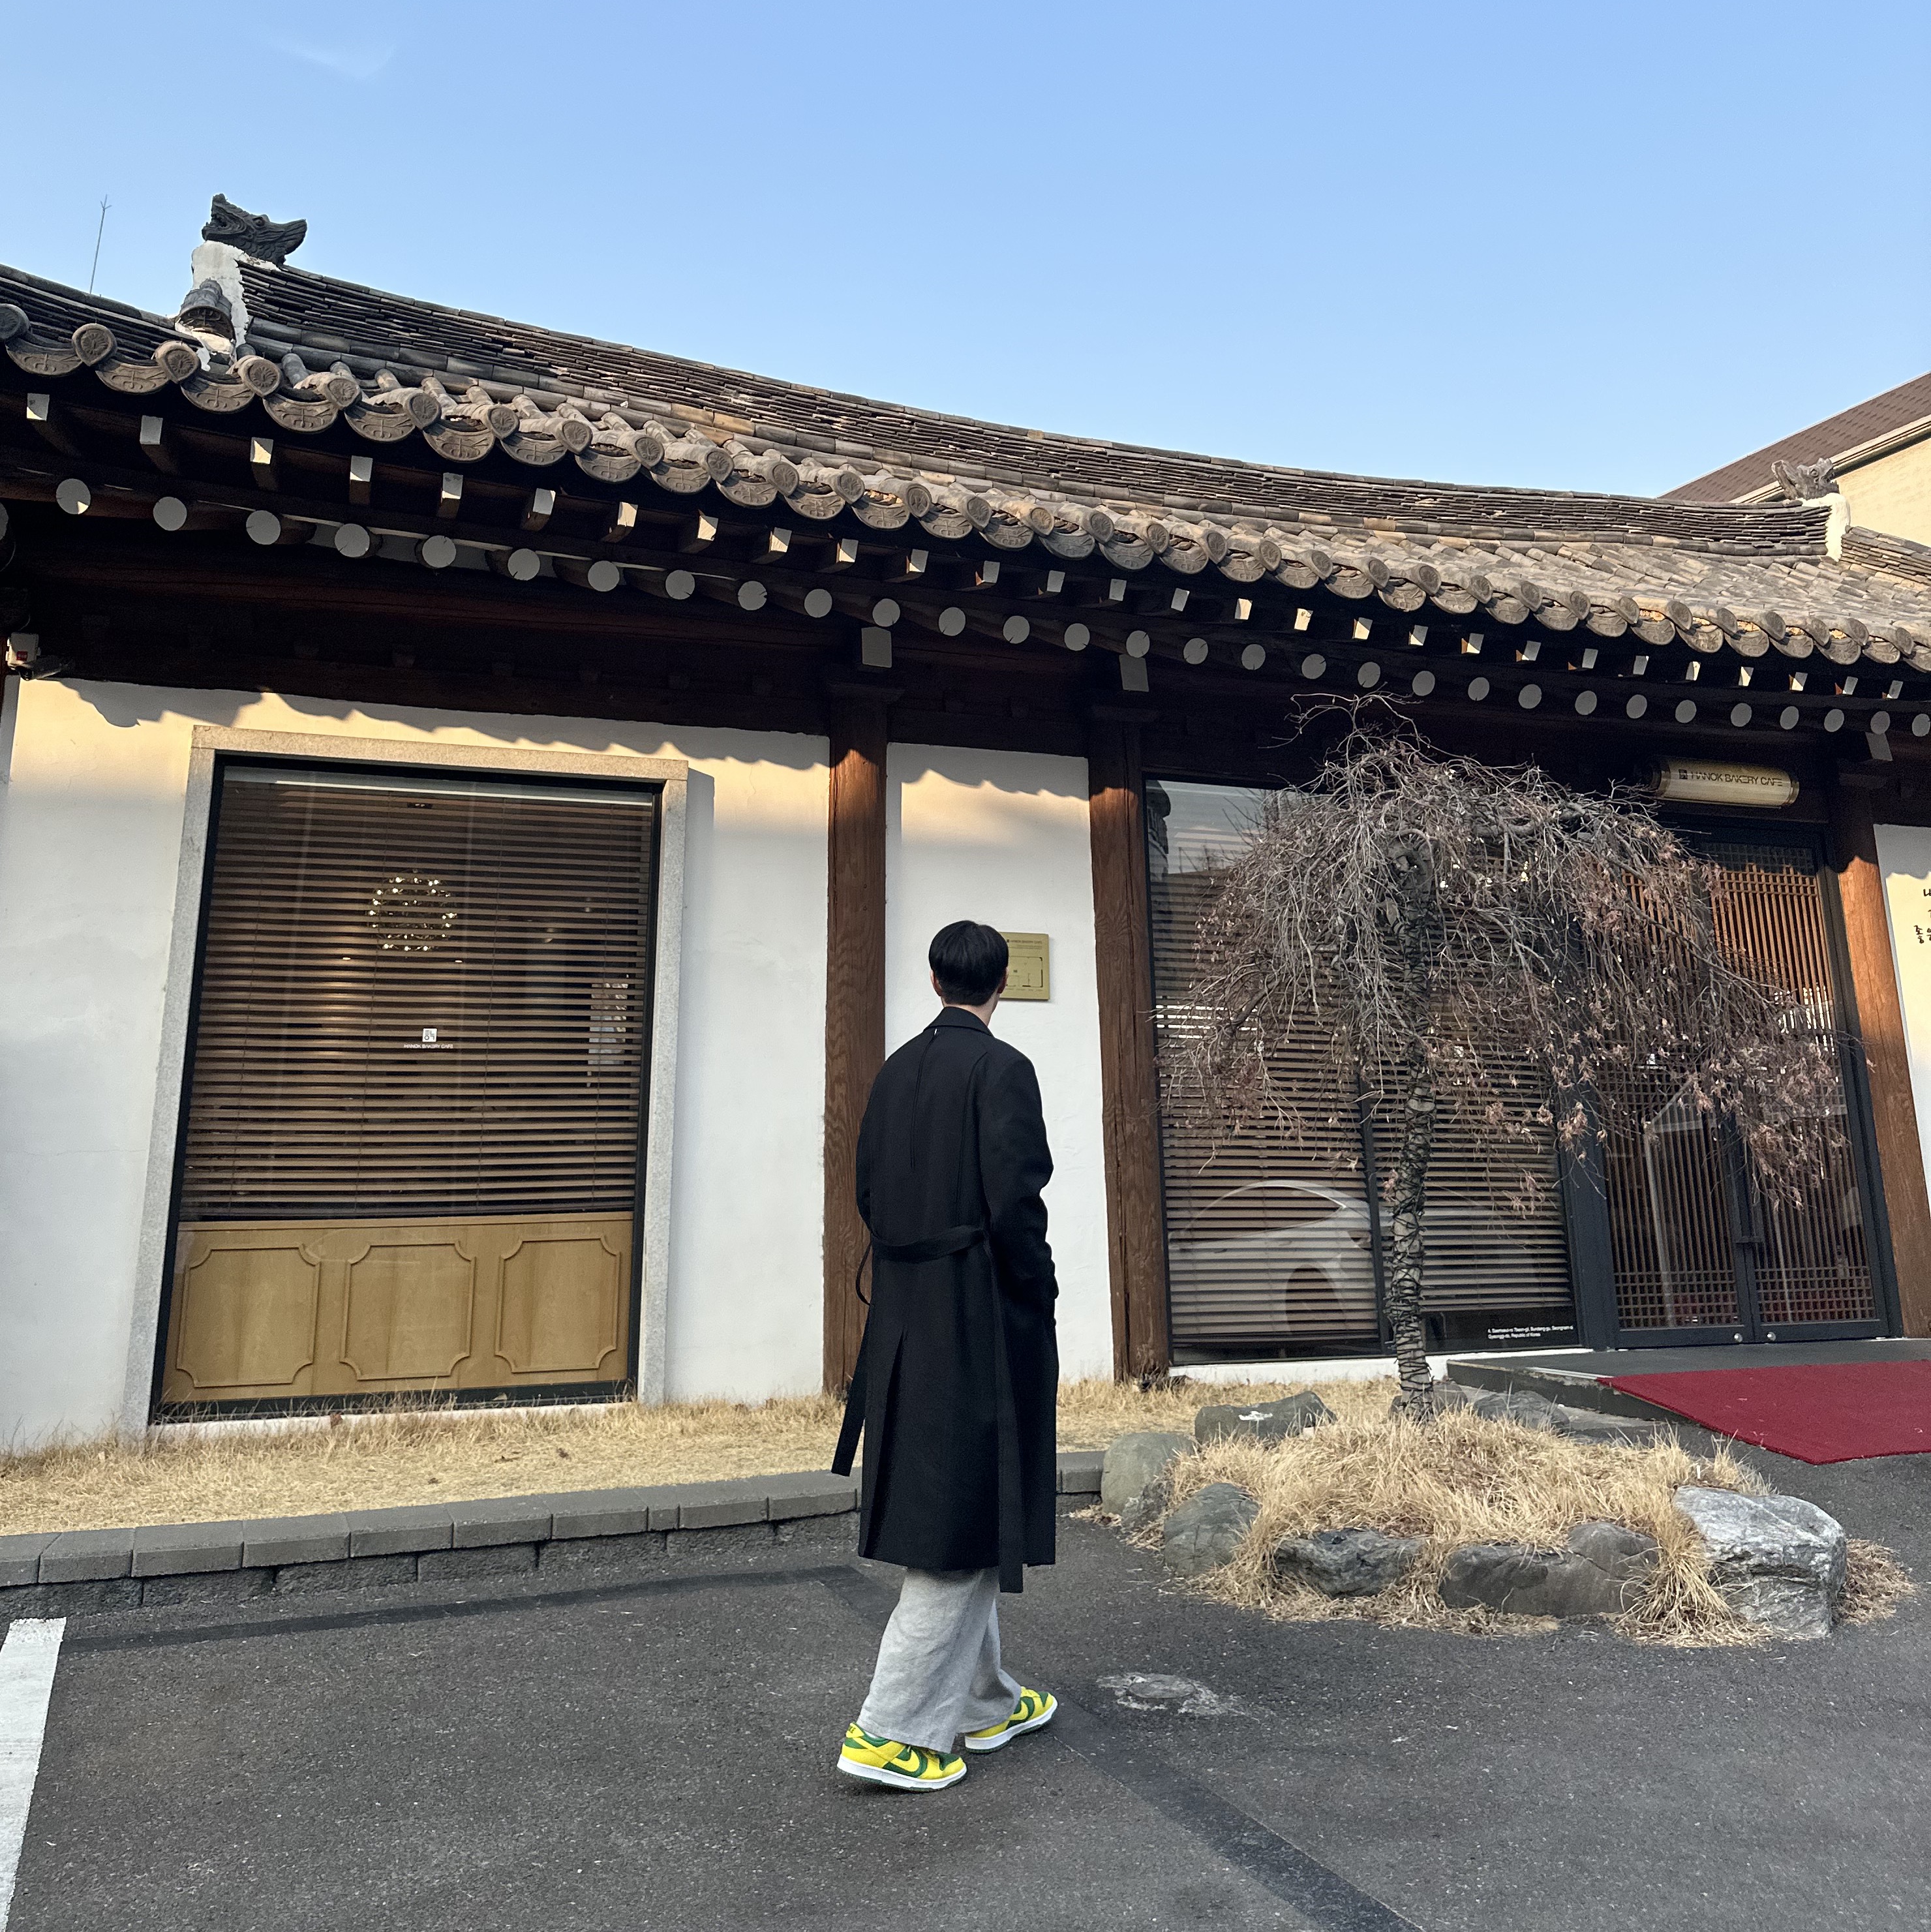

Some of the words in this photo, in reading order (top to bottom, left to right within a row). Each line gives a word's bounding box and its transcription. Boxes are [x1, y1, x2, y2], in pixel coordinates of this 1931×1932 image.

[1690, 771, 1722, 781] HANOK
[1724, 773, 1758, 784] BAKERY
[1760, 776, 1782, 786] CAFE
